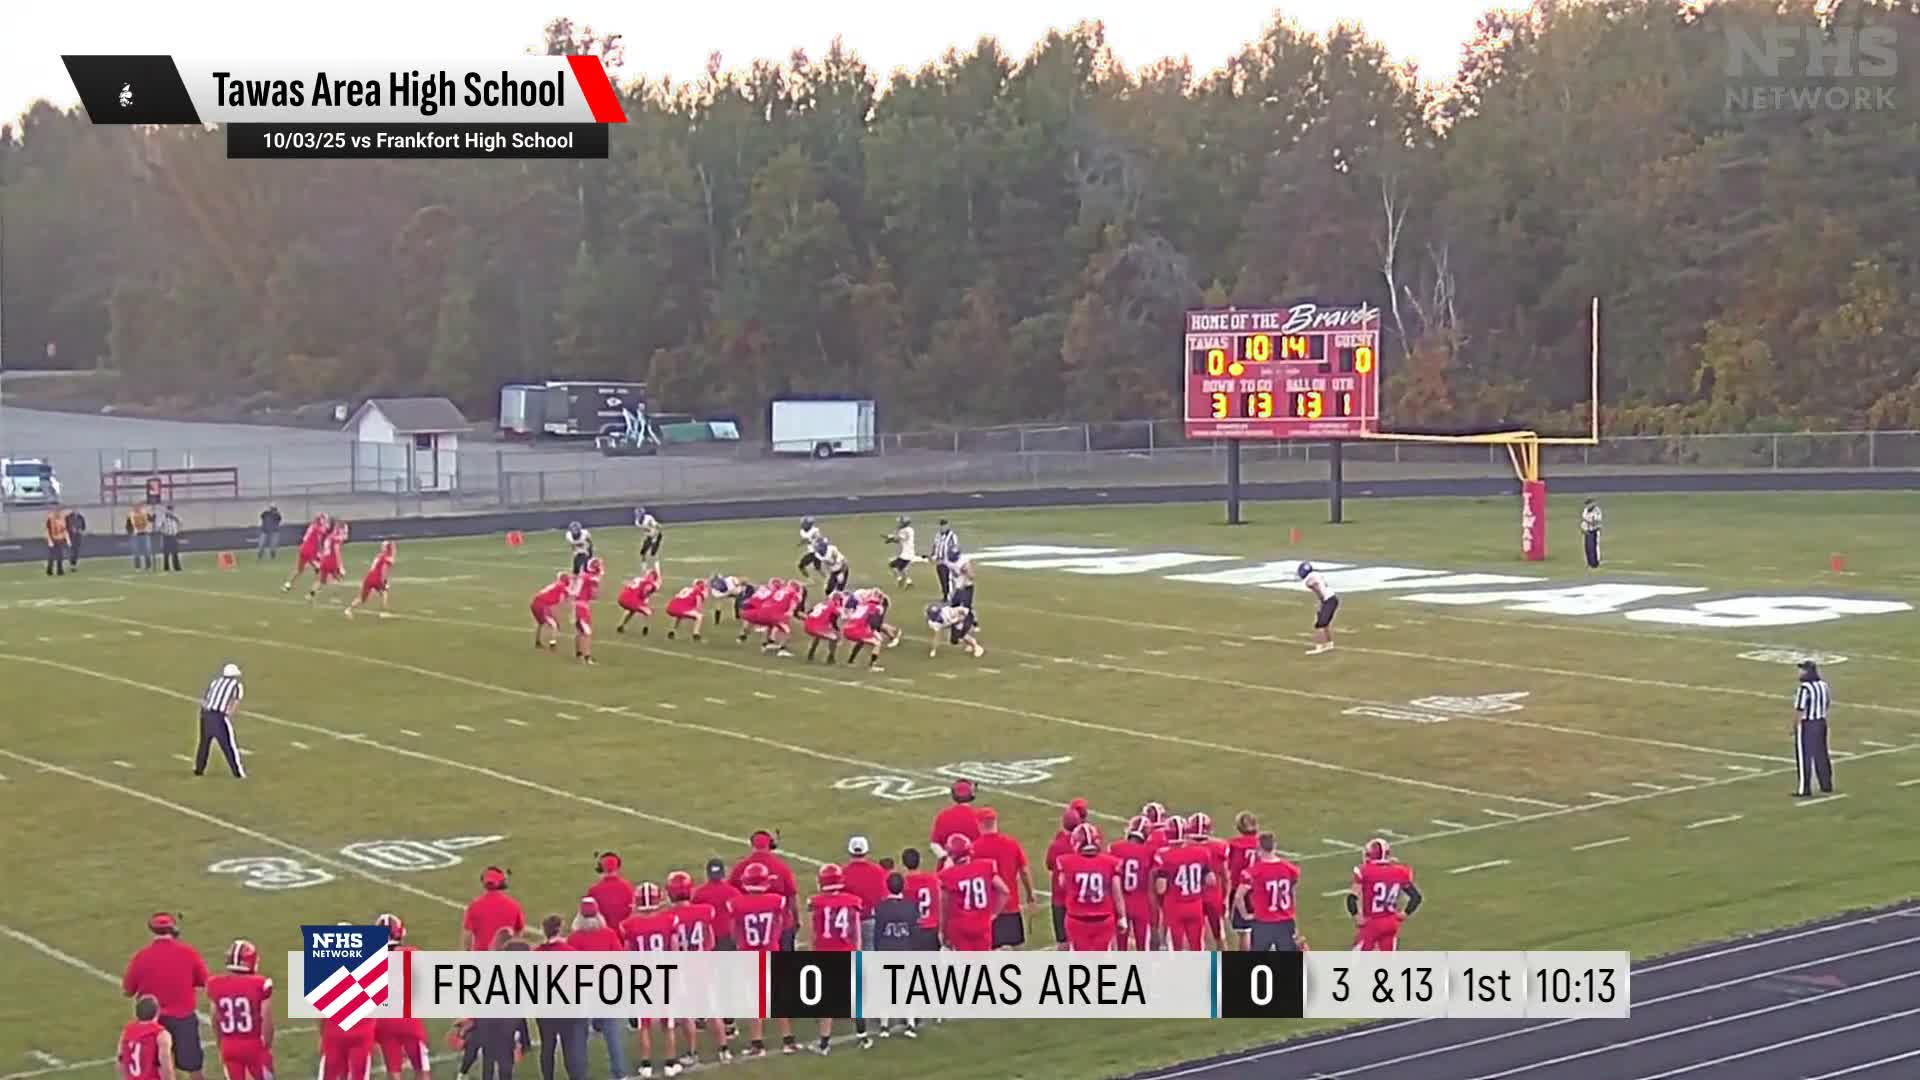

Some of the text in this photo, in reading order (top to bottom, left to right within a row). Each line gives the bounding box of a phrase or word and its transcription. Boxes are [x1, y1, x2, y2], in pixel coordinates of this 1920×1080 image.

[1191, 314, 1229, 330] HOME
[1230, 314, 1249, 330] OF
[1251, 313, 1279, 328] THE
[1208, 349, 1224, 376] 0
[1355, 347, 1371, 373] 0
[1212, 392, 1227, 418] 3
[1248, 392, 1272, 418] 13
[1297, 391, 1322, 418] 13
[1343, 393, 1351, 416] 1
[958, 877, 987, 910] 78
[1076, 872, 1104, 903] 79
[1174, 863, 1201, 896] 40
[1266, 879, 1291, 911] 73
[1371, 882, 1400, 913] 24
[744, 912, 774, 946] 67
[823, 906, 849, 939] 14
[219, 997, 252, 1033] 33
